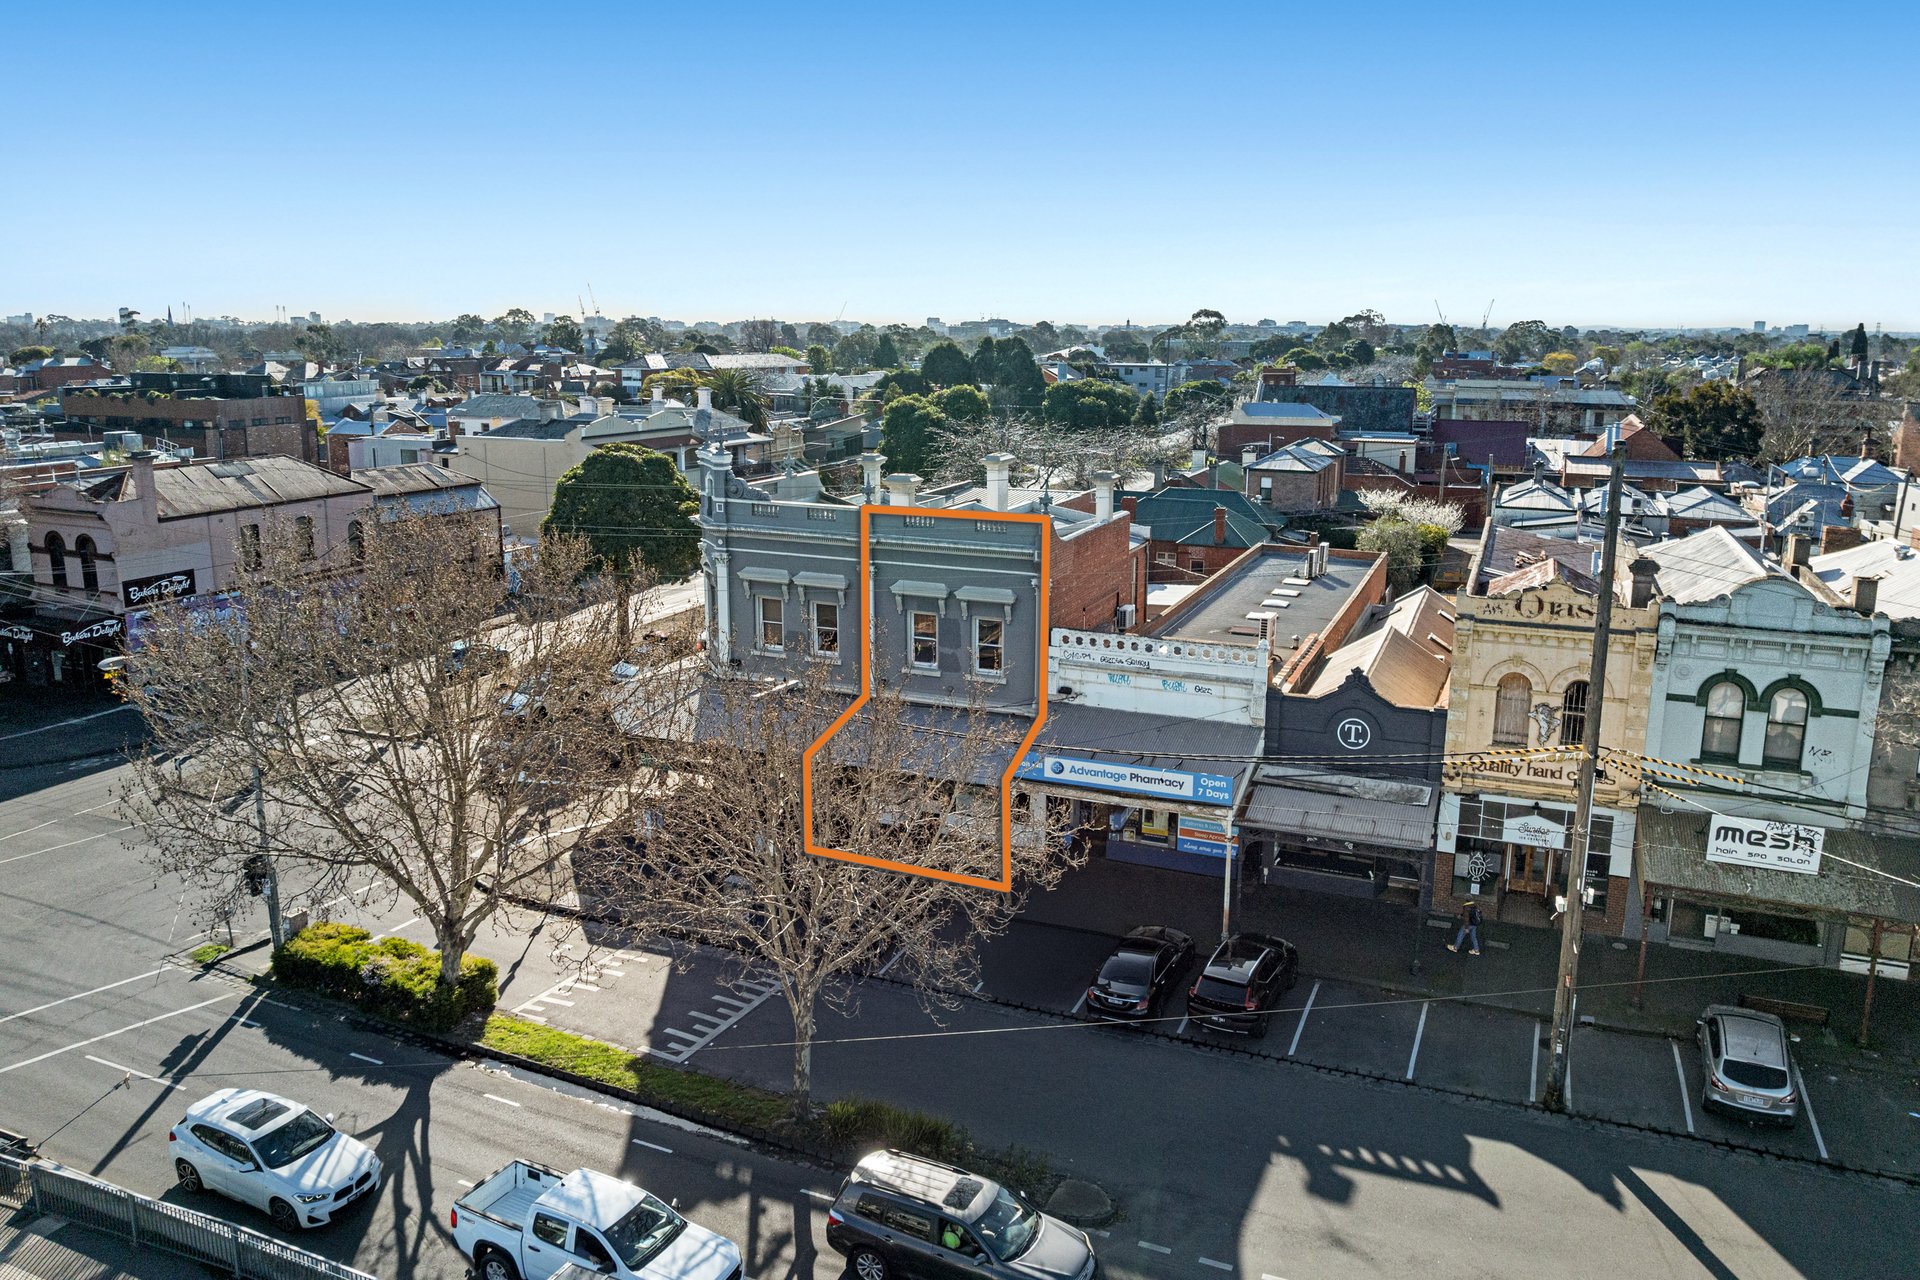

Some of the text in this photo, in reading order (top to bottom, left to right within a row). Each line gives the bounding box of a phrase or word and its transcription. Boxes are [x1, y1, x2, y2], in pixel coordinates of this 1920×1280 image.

[128, 578, 191, 603] Bakers Delight
[61, 622, 122, 647] Bakers Delight
[1069, 765, 1184, 790] Advantage Pharmacy
[1468, 754, 1523, 777] Quality
[1526, 761, 1563, 780] hand
[1197, 788, 1229, 800] 7 Days
[1200, 777, 1227, 788] Open
[1715, 826, 1816, 853] mesh
[1715, 846, 1738, 855] hair
